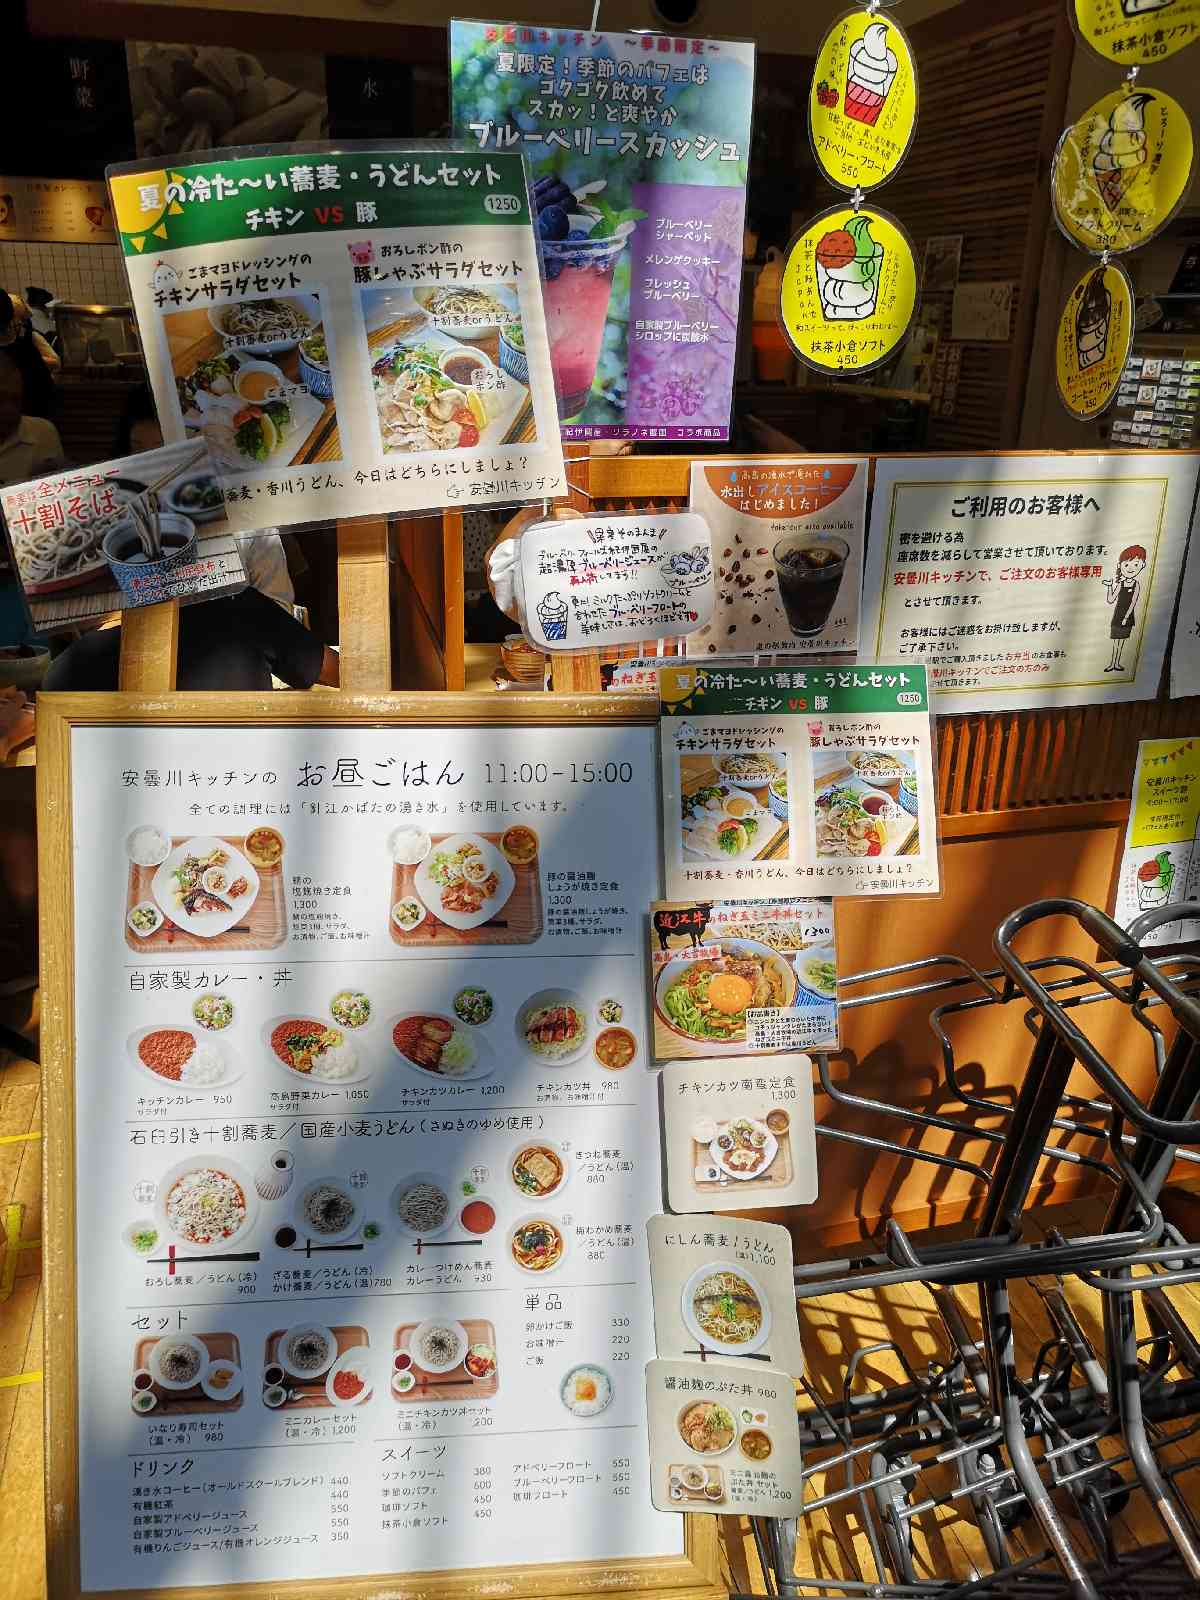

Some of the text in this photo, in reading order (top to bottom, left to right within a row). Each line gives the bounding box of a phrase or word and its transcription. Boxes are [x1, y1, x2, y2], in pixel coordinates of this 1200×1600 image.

[540, 80, 666, 102] ゴクゴク飲めて
[528, 100, 677, 127] スカッ！と爽やか
[469, 120, 741, 161] ブルーベリースカッシュ
[841, 164, 858, 178] 550
[486, 197, 518, 212] 1250
[245, 201, 378, 231] チキン VS 豚
[656, 218, 713, 231] ブルーベリー
[354, 260, 524, 283] 豚しゃぶサラダセット
[154, 275, 302, 306] チキンサラダセット
[837, 355, 858, 364] 450
[12, 489, 118, 536] 十割そば
[951, 494, 1100, 517] ご利用のお客様へ
[899, 531, 964, 545] 密を避ける為
[745, 696, 829, 711] チキン VS 豚
[676, 737, 776, 750] チキンサラダセット
[121, 769, 281, 788] 安曇川キッチンの
[297, 757, 465, 788] お昼ごはん
[129, 968, 294, 992] 自家製カレー・丼
[536, 1081, 591, 1092] チキンカツ丼
[136, 1096, 205, 1106] キッチンカレー
[524, 1293, 562, 1311] 単品
[131, 1311, 188, 1330] セット
[381, 1445, 447, 1462] スイーツ
[132, 1460, 194, 1478] ドリンク
[382, 1470, 446, 1481] ソフトクリーム
